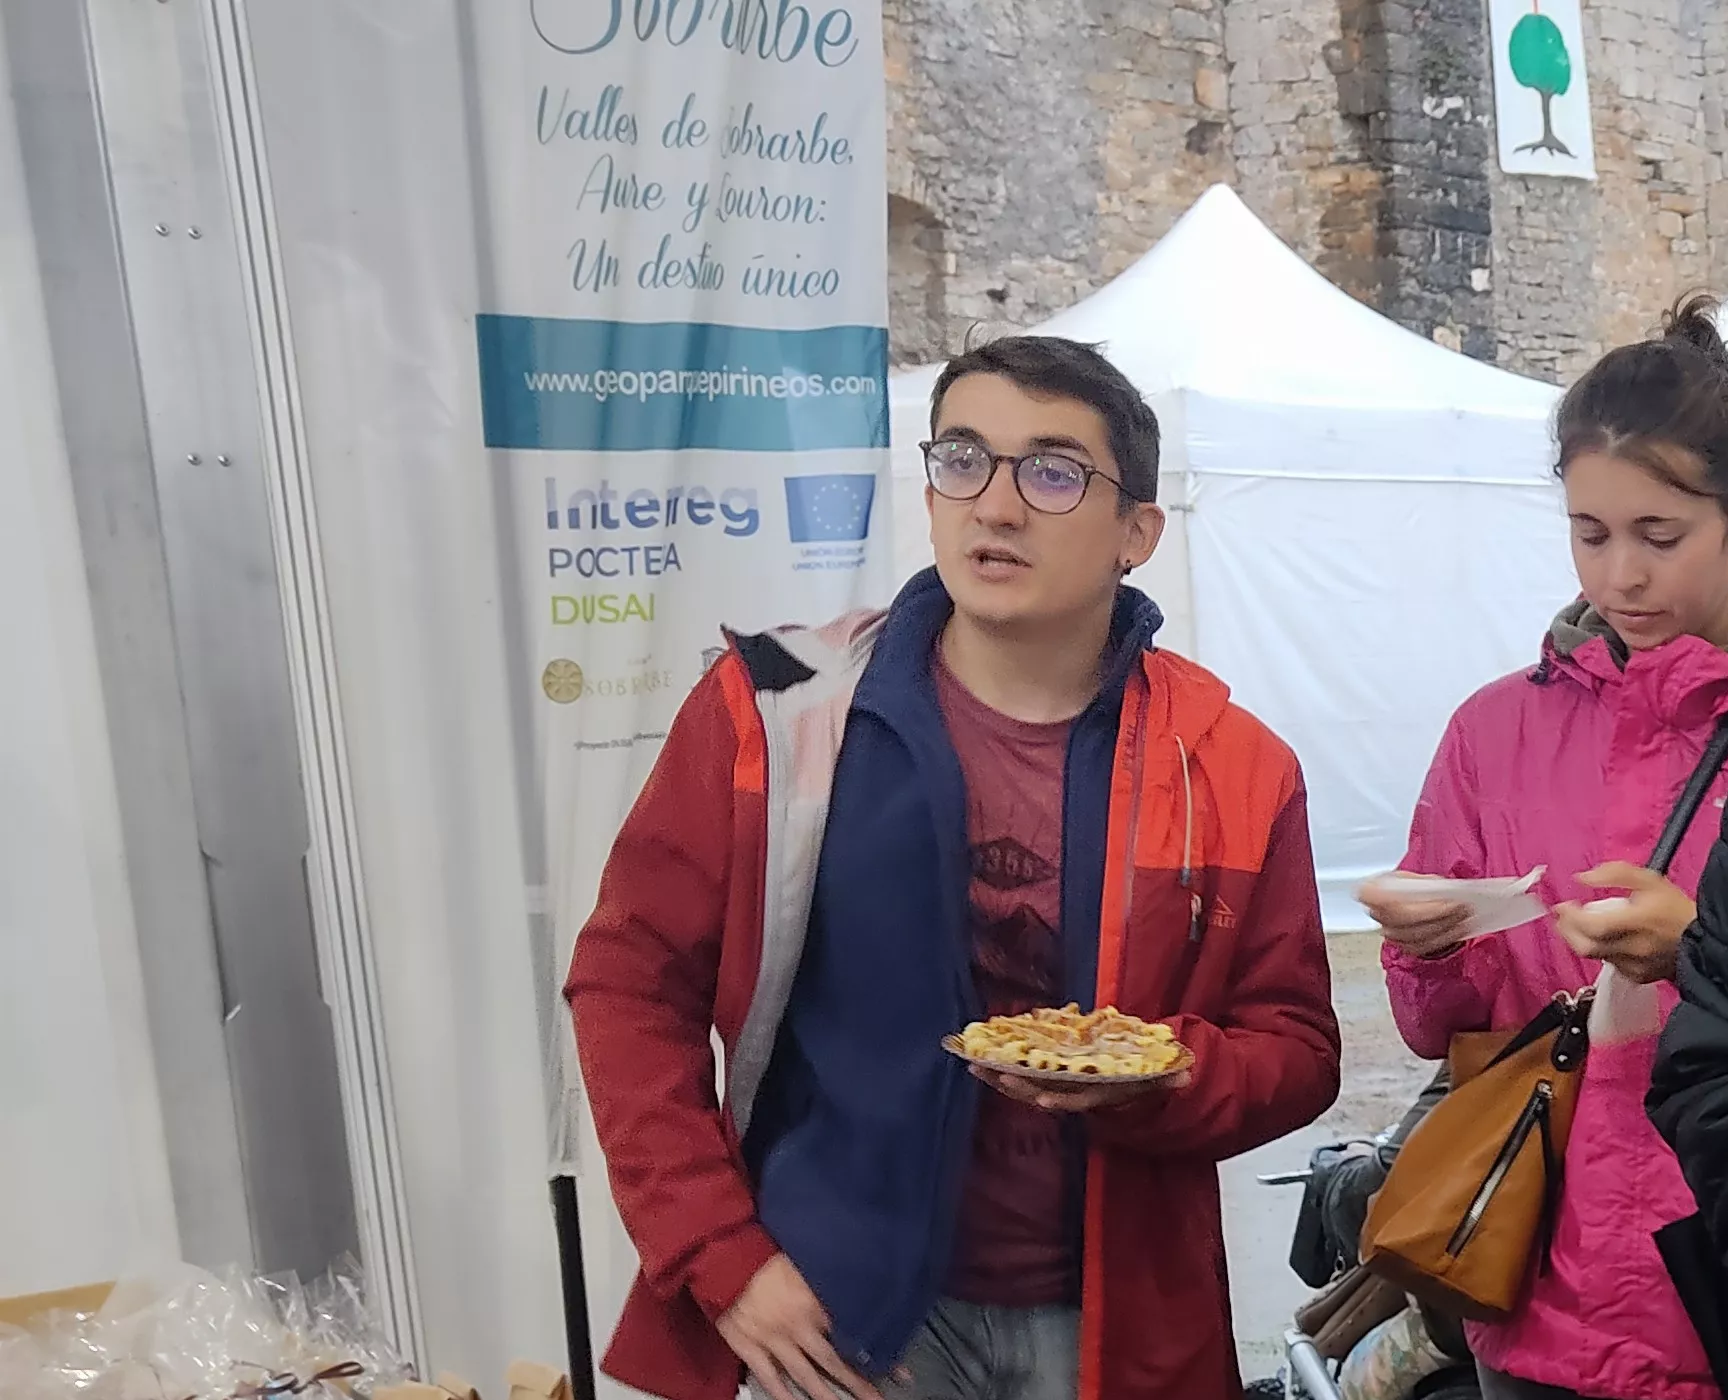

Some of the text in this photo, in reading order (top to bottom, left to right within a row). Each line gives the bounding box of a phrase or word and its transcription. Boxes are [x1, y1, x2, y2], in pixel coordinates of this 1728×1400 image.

[536, 83, 639, 149] Valles
[661, 92, 709, 149] de
[576, 153, 665, 214] Aure
[682, 180, 709, 233] y
[567, 238, 620, 293] Un
[741, 254, 840, 299] único
[523, 365, 877, 402] www.geoparqepirineos.com
